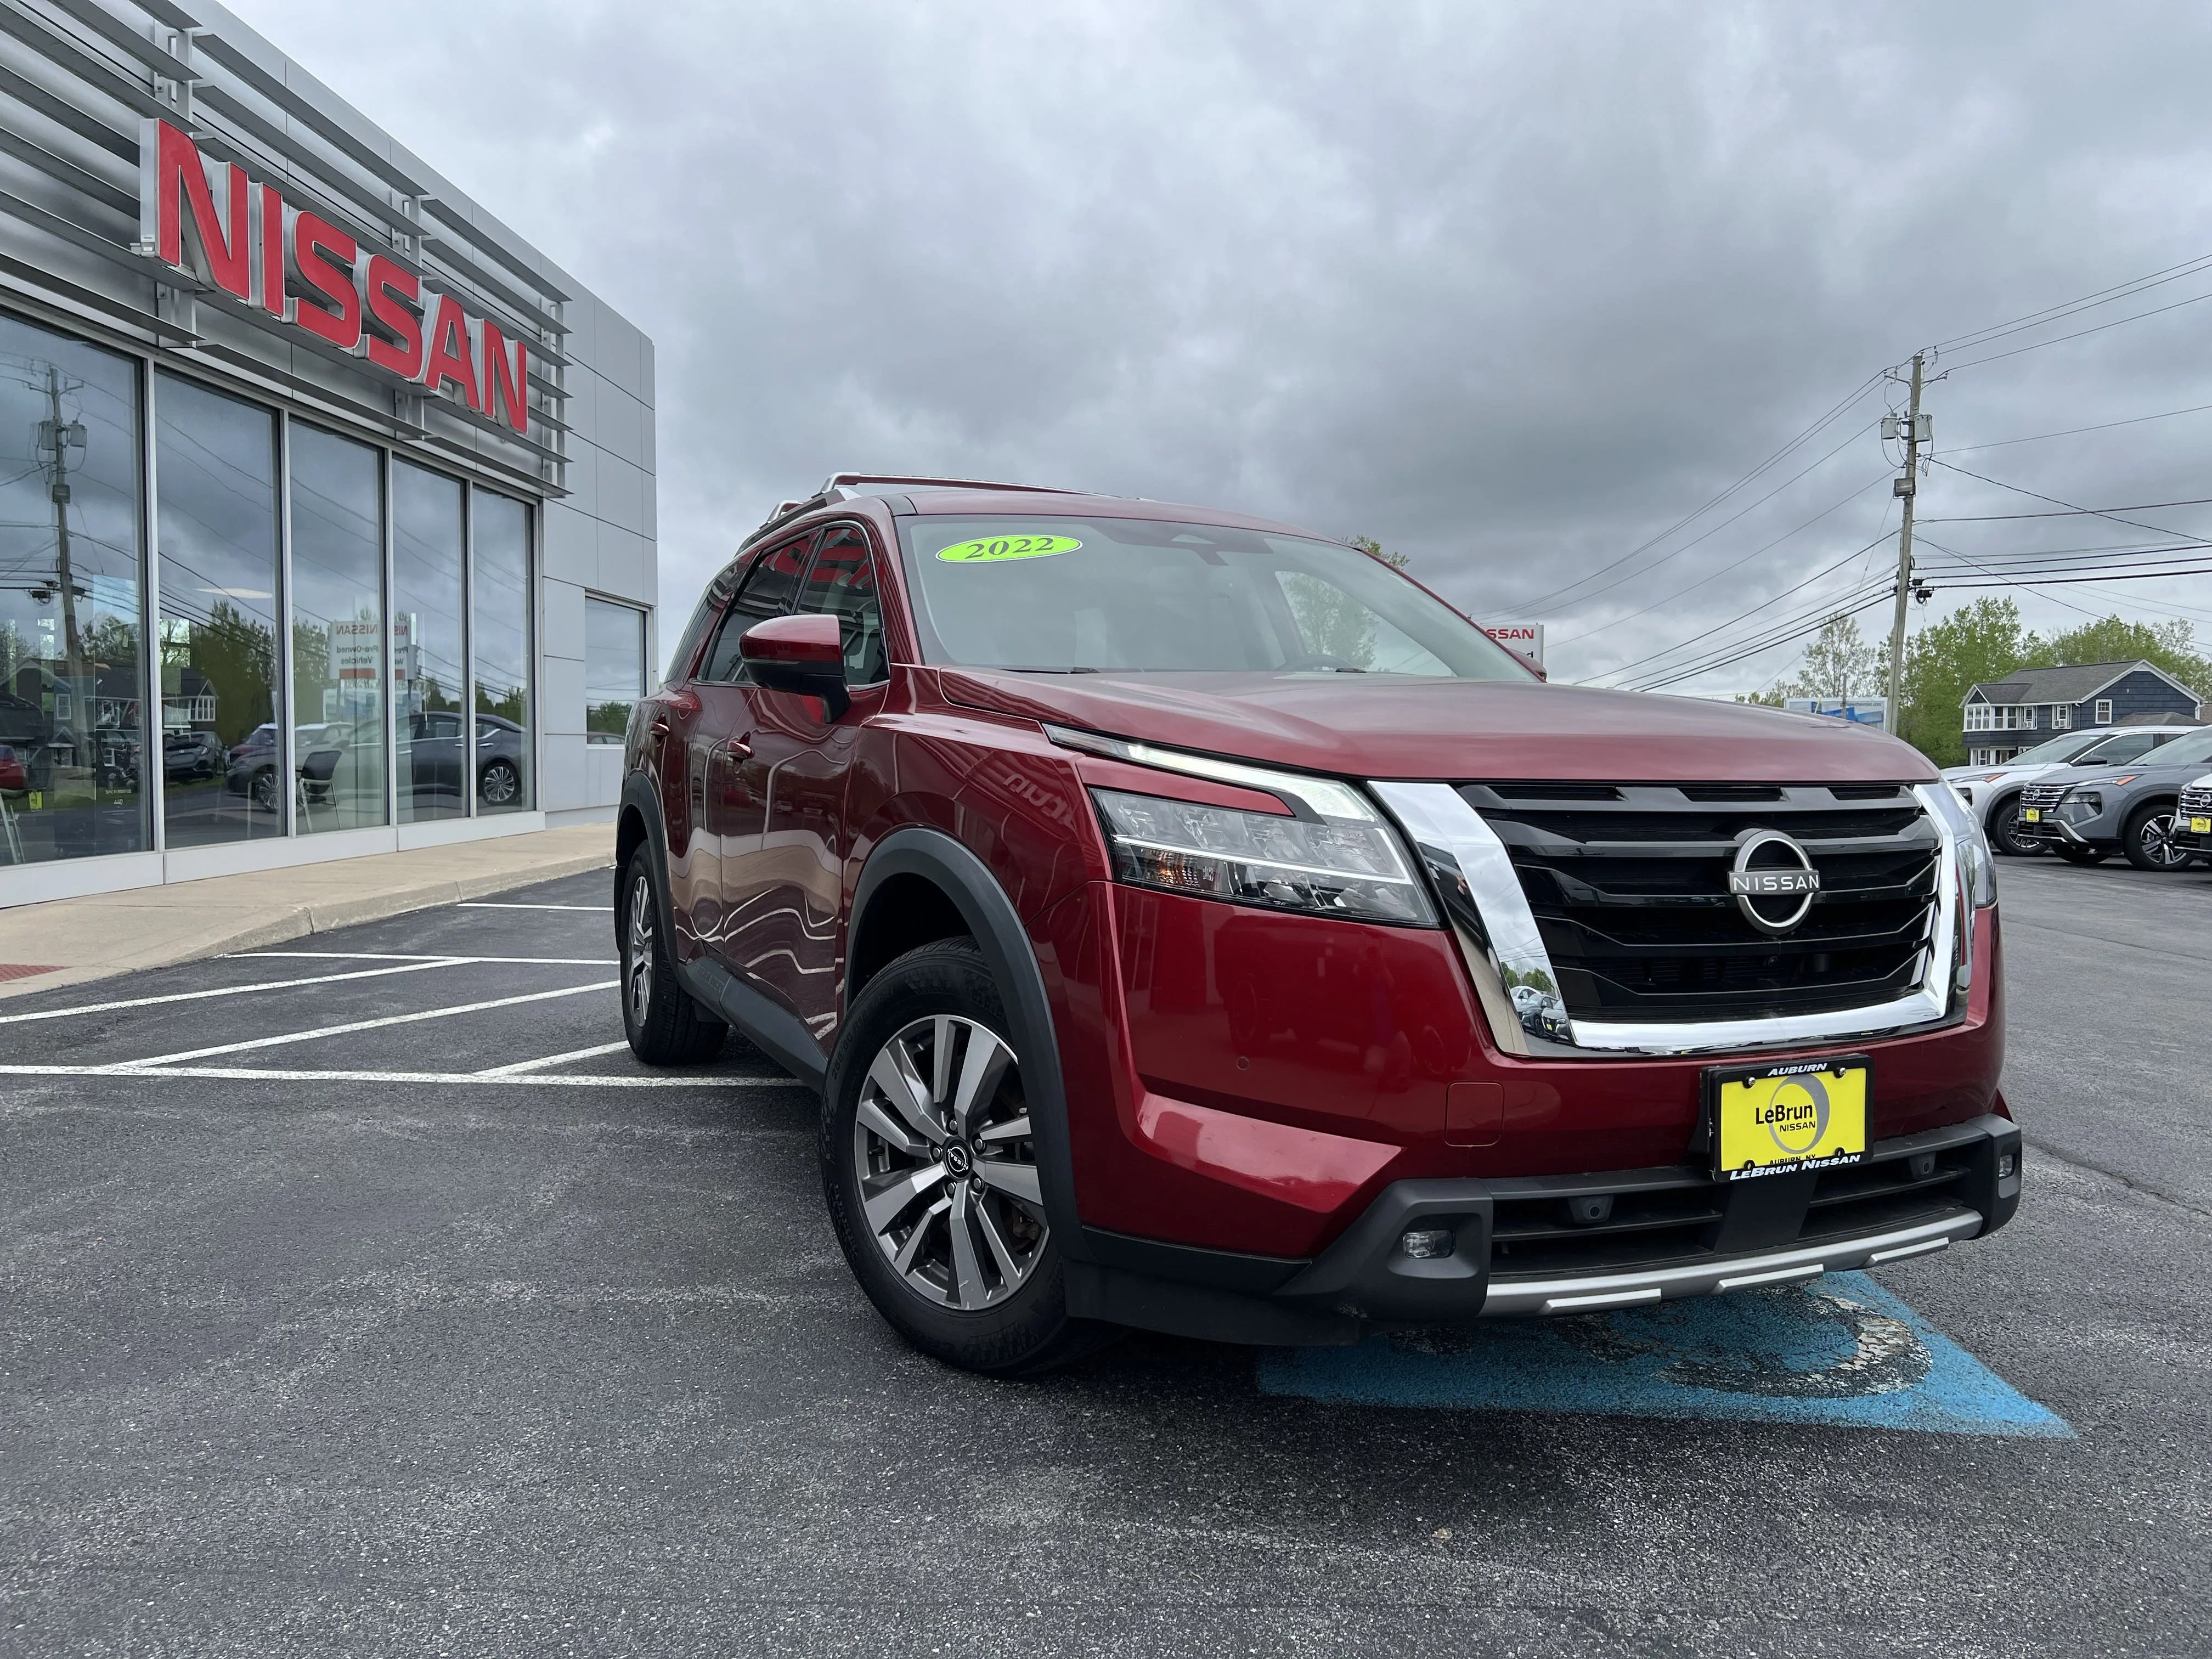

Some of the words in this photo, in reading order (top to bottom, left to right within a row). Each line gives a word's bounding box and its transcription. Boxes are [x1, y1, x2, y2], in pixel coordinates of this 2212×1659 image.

[156, 117, 529, 435] NISSAN
[964, 537, 1054, 559] 2022
[1485, 629, 1534, 639] SSAN
[1733, 874, 1819, 891] NISSAN
[1767, 1063, 1827, 1076] AUBURN
[1756, 1104, 1813, 1125] LeBrun
[1779, 1120, 1816, 1133] NISSAN
[947, 1149, 969, 1170] NISSAN
[1769, 1156, 1801, 1165] AUBURN
[1801, 1155, 1861, 1170] NISSAN
